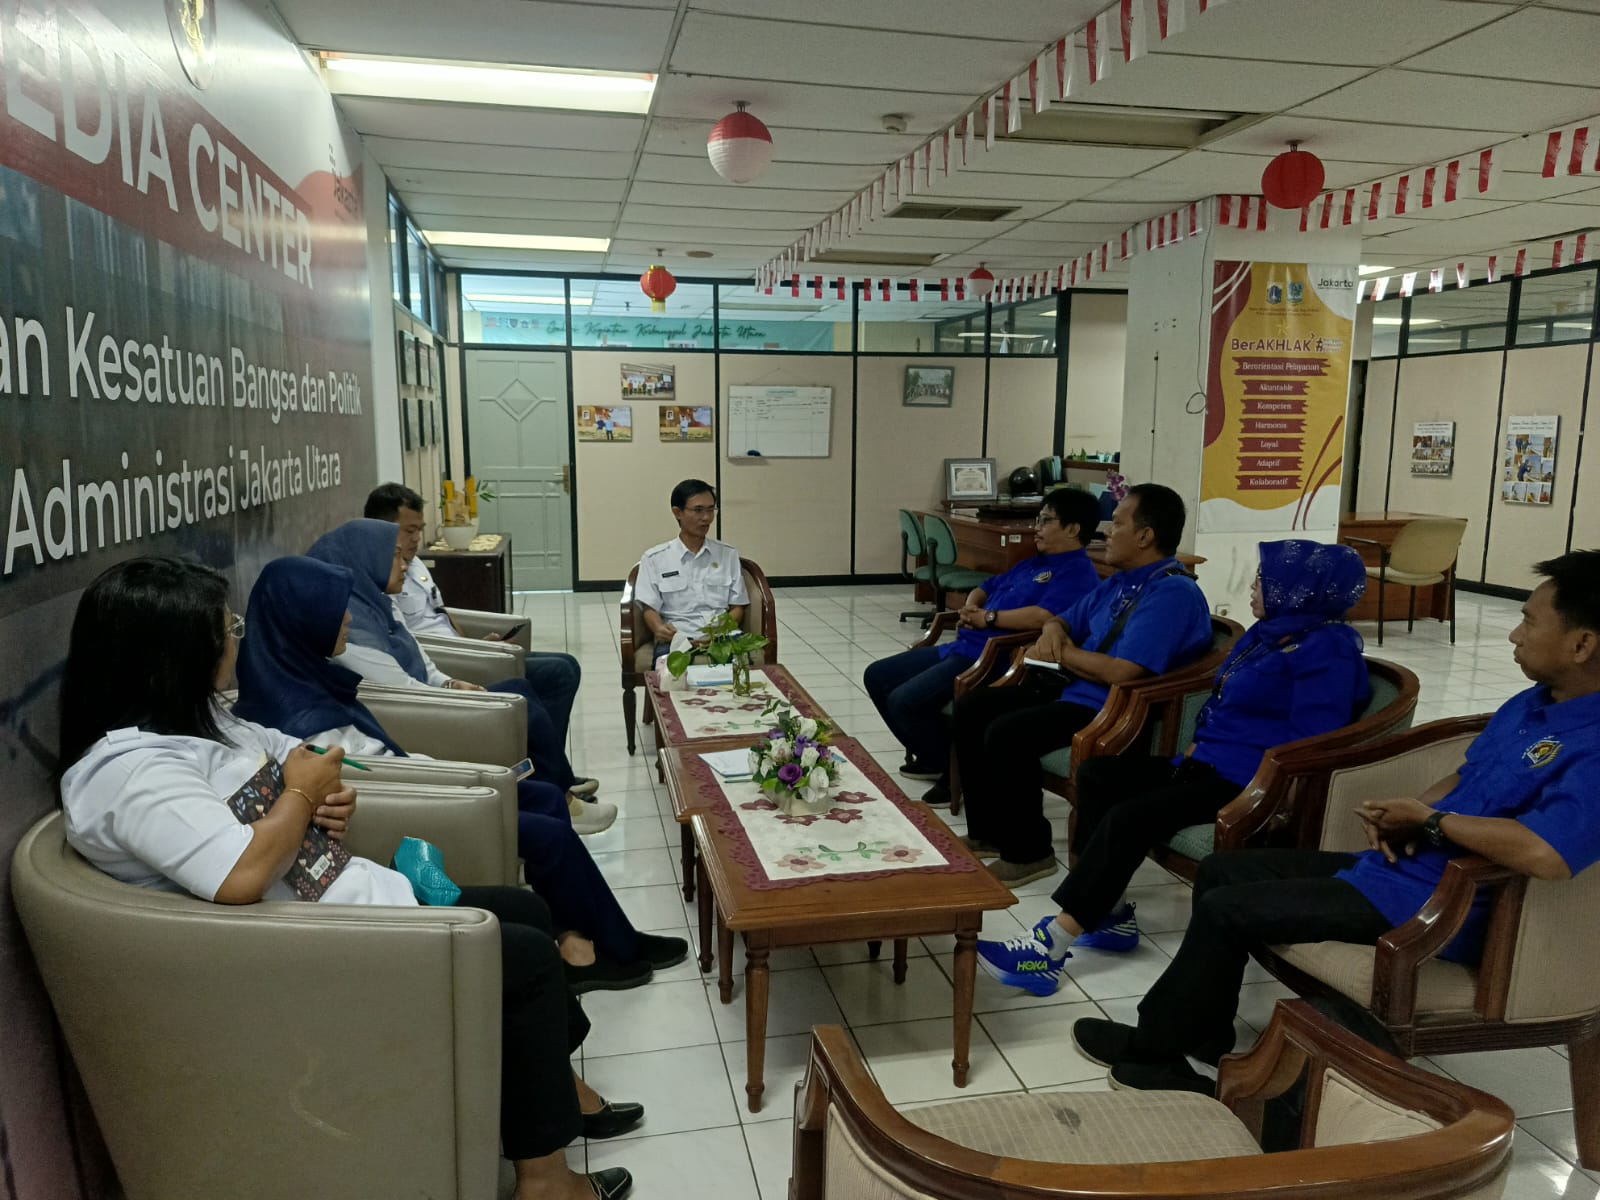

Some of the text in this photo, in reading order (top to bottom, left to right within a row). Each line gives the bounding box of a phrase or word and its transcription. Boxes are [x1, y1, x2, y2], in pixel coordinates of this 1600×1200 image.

[188, 123, 313, 289] CENTER
[1231, 338, 1311, 352] BerAKHLAK
[65, 306, 225, 407] Kesatuan
[230, 347, 298, 424] Bangsa
[301, 363, 327, 413] dan
[328, 371, 362, 415] Politik
[1242, 361, 1319, 372] Berorientasi Pelayanan
[1257, 402, 1292, 411] Kompeten
[1255, 421, 1287, 429] Harmonis
[1260, 440, 1279, 448] Loyal
[1256, 459, 1280, 468] Adaptif
[1249, 478, 1288, 486] Kolaboratif
[3, 445, 341, 576] Administrasi Jakarta Utara
[1016, 960, 1048, 972] HOKA
